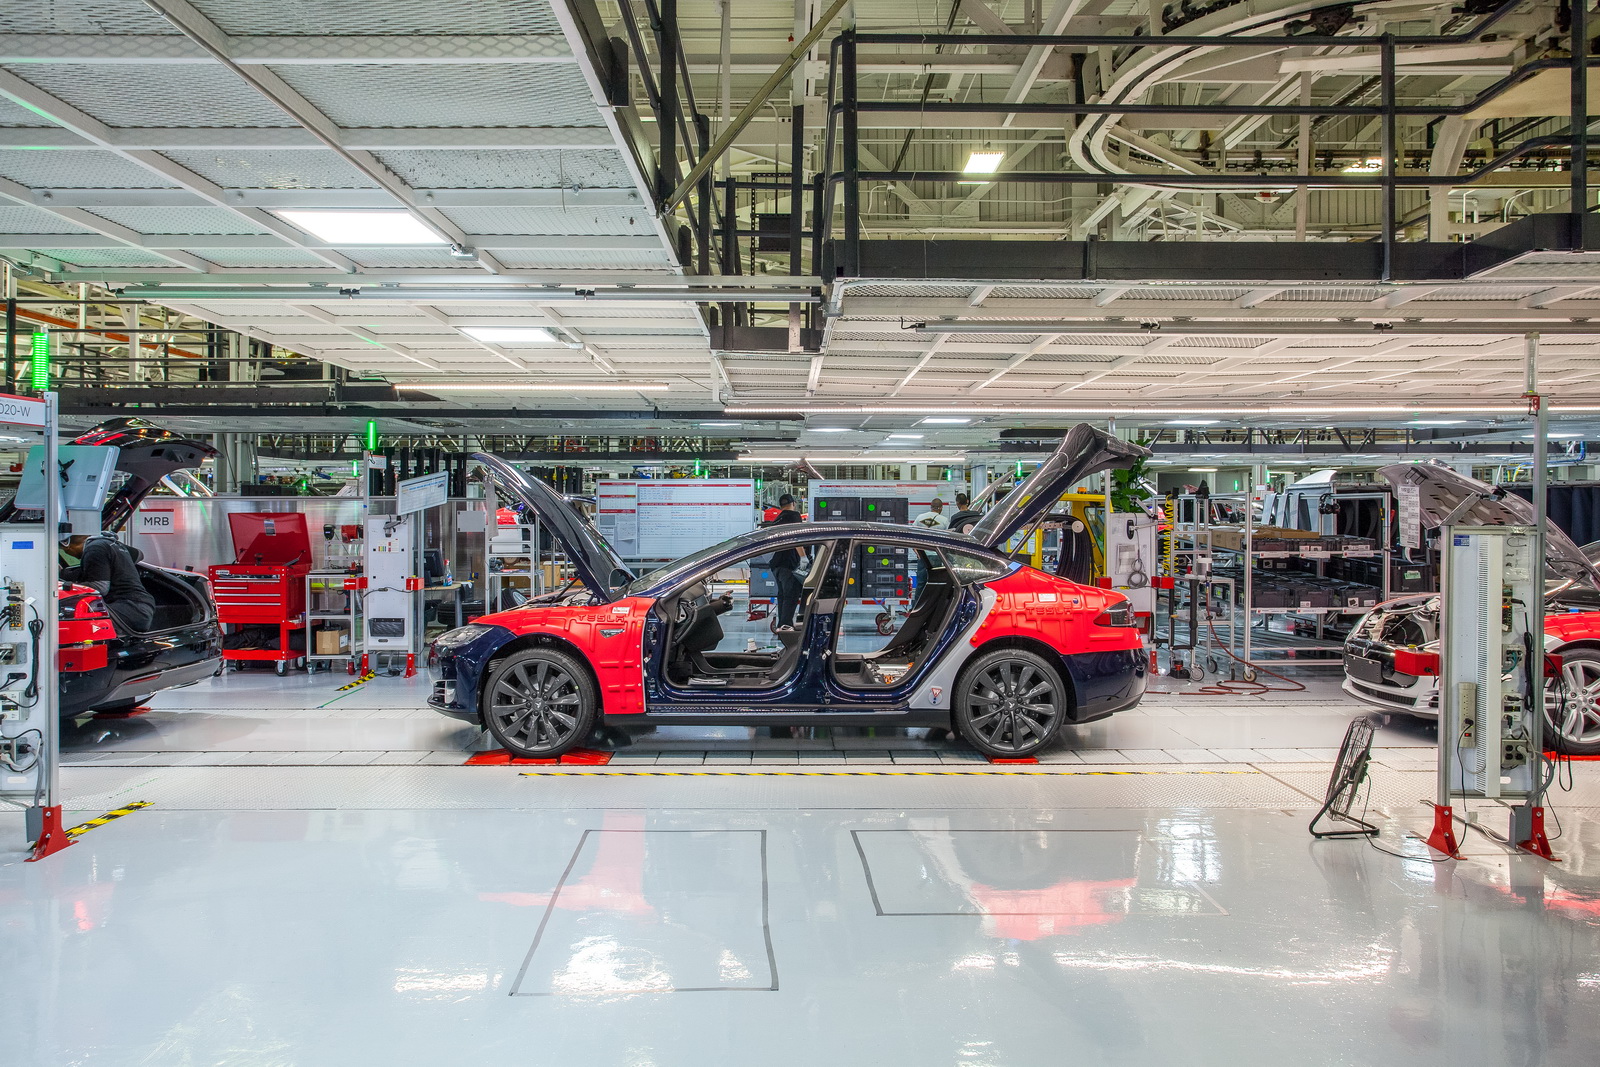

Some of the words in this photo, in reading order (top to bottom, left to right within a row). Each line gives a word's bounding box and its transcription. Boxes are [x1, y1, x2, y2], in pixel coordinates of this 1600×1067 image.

[143, 516, 170, 526] MRB
[1025, 606, 1073, 615] TESLA
[578, 614, 625, 623] TESLA
